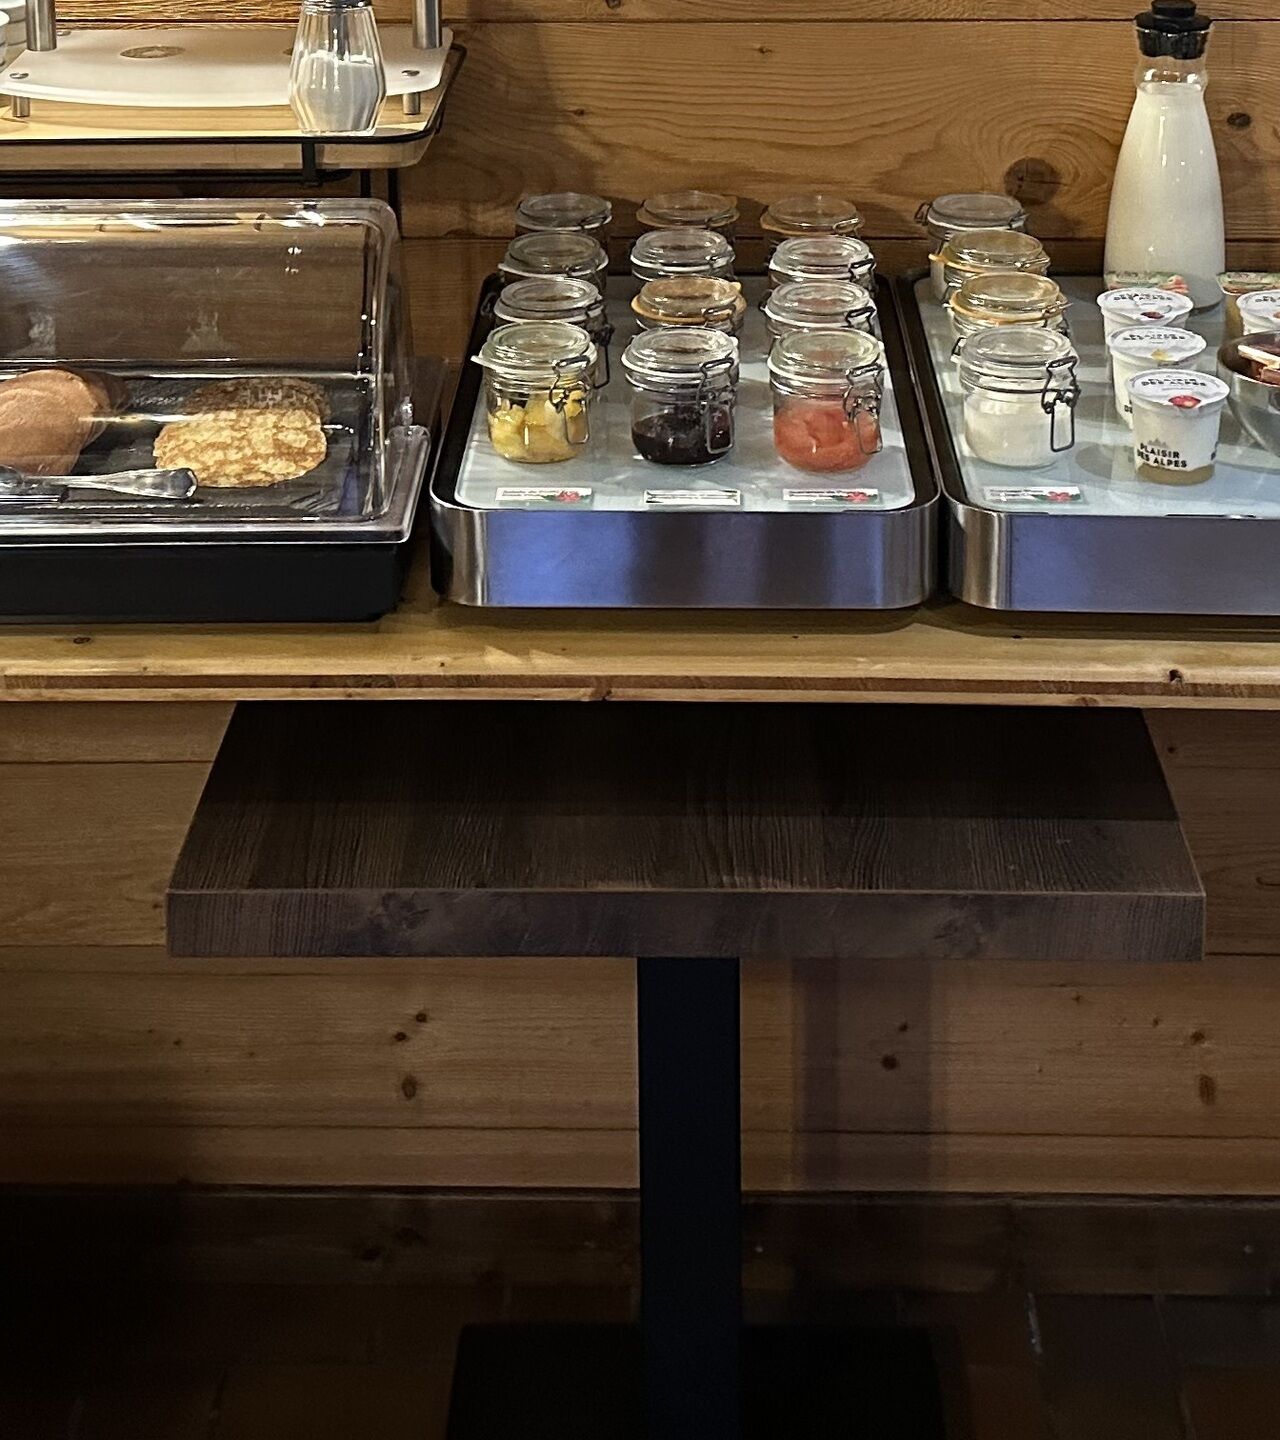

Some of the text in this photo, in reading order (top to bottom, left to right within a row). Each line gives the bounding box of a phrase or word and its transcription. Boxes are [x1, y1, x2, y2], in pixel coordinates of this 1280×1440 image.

[1137, 449, 1188, 468] DES ALPES
[1140, 442, 1180, 459] PLAISIR
